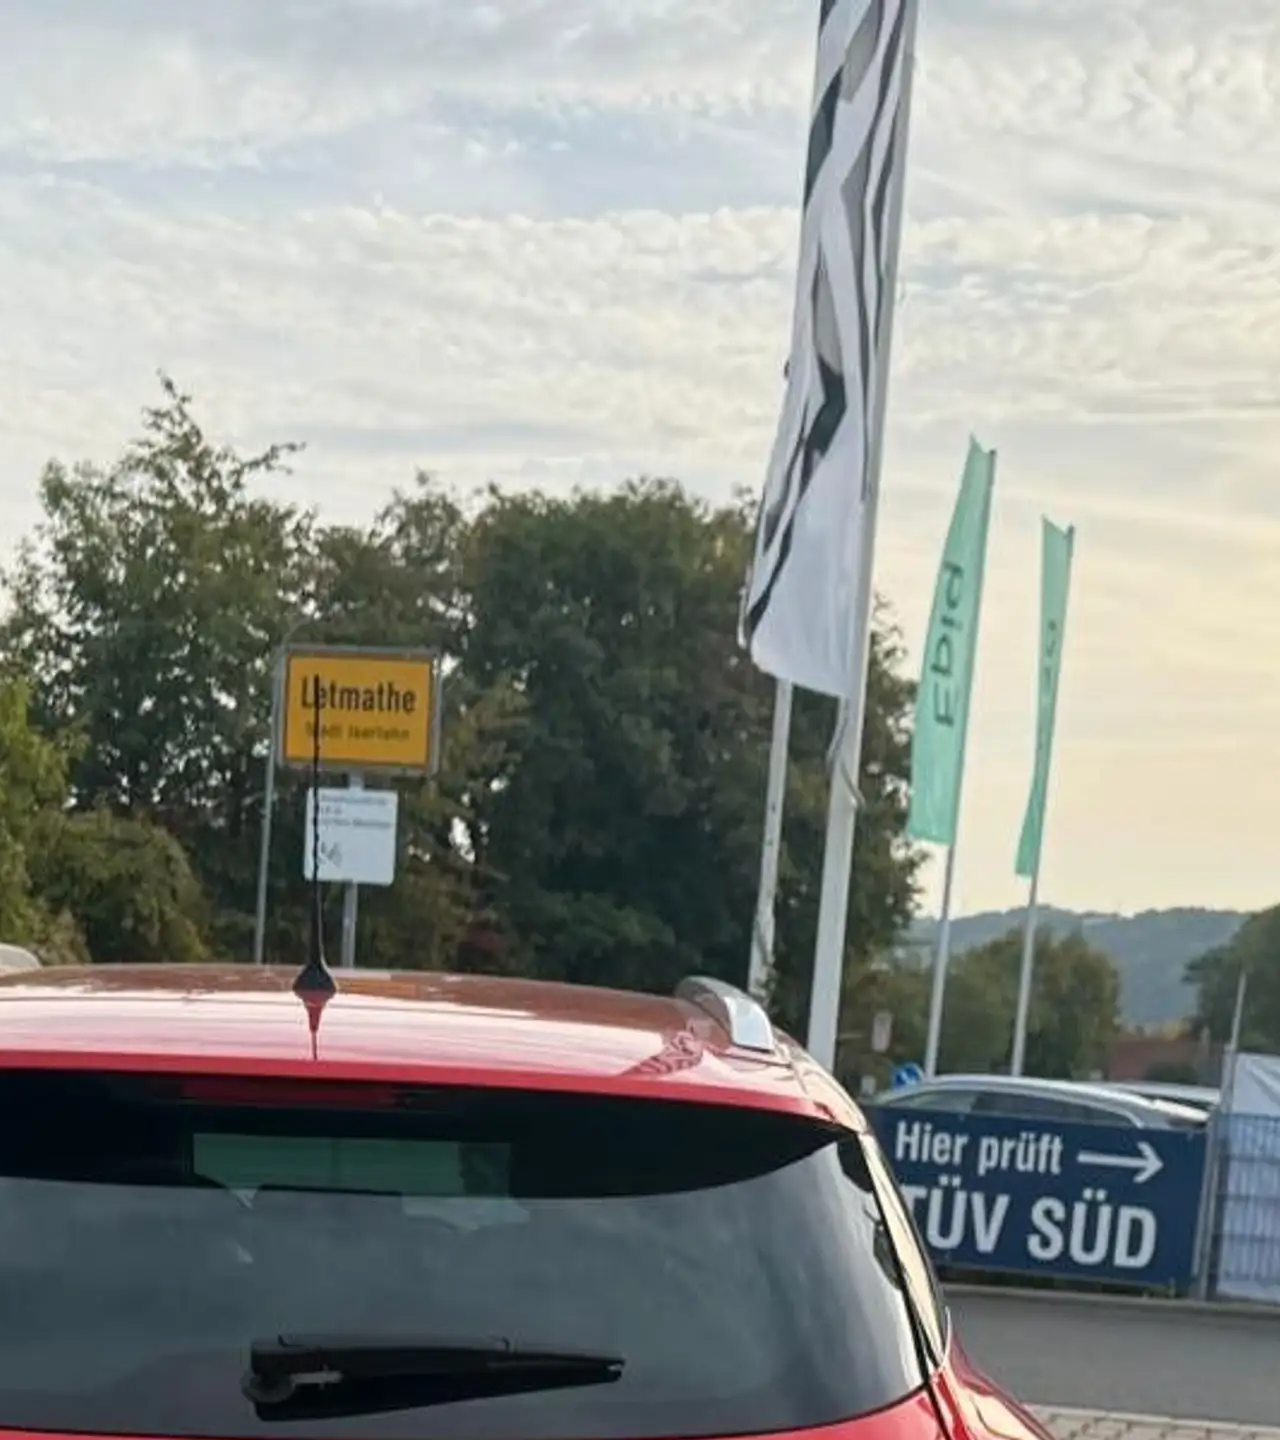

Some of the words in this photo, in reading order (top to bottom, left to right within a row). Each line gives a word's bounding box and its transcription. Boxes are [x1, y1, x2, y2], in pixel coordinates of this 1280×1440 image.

[301, 675, 416, 712] Letmathe
[896, 1120, 970, 1168] Hier
[977, 1130, 1064, 1179] prüft
[1027, 1187, 1157, 1269] SÜD
